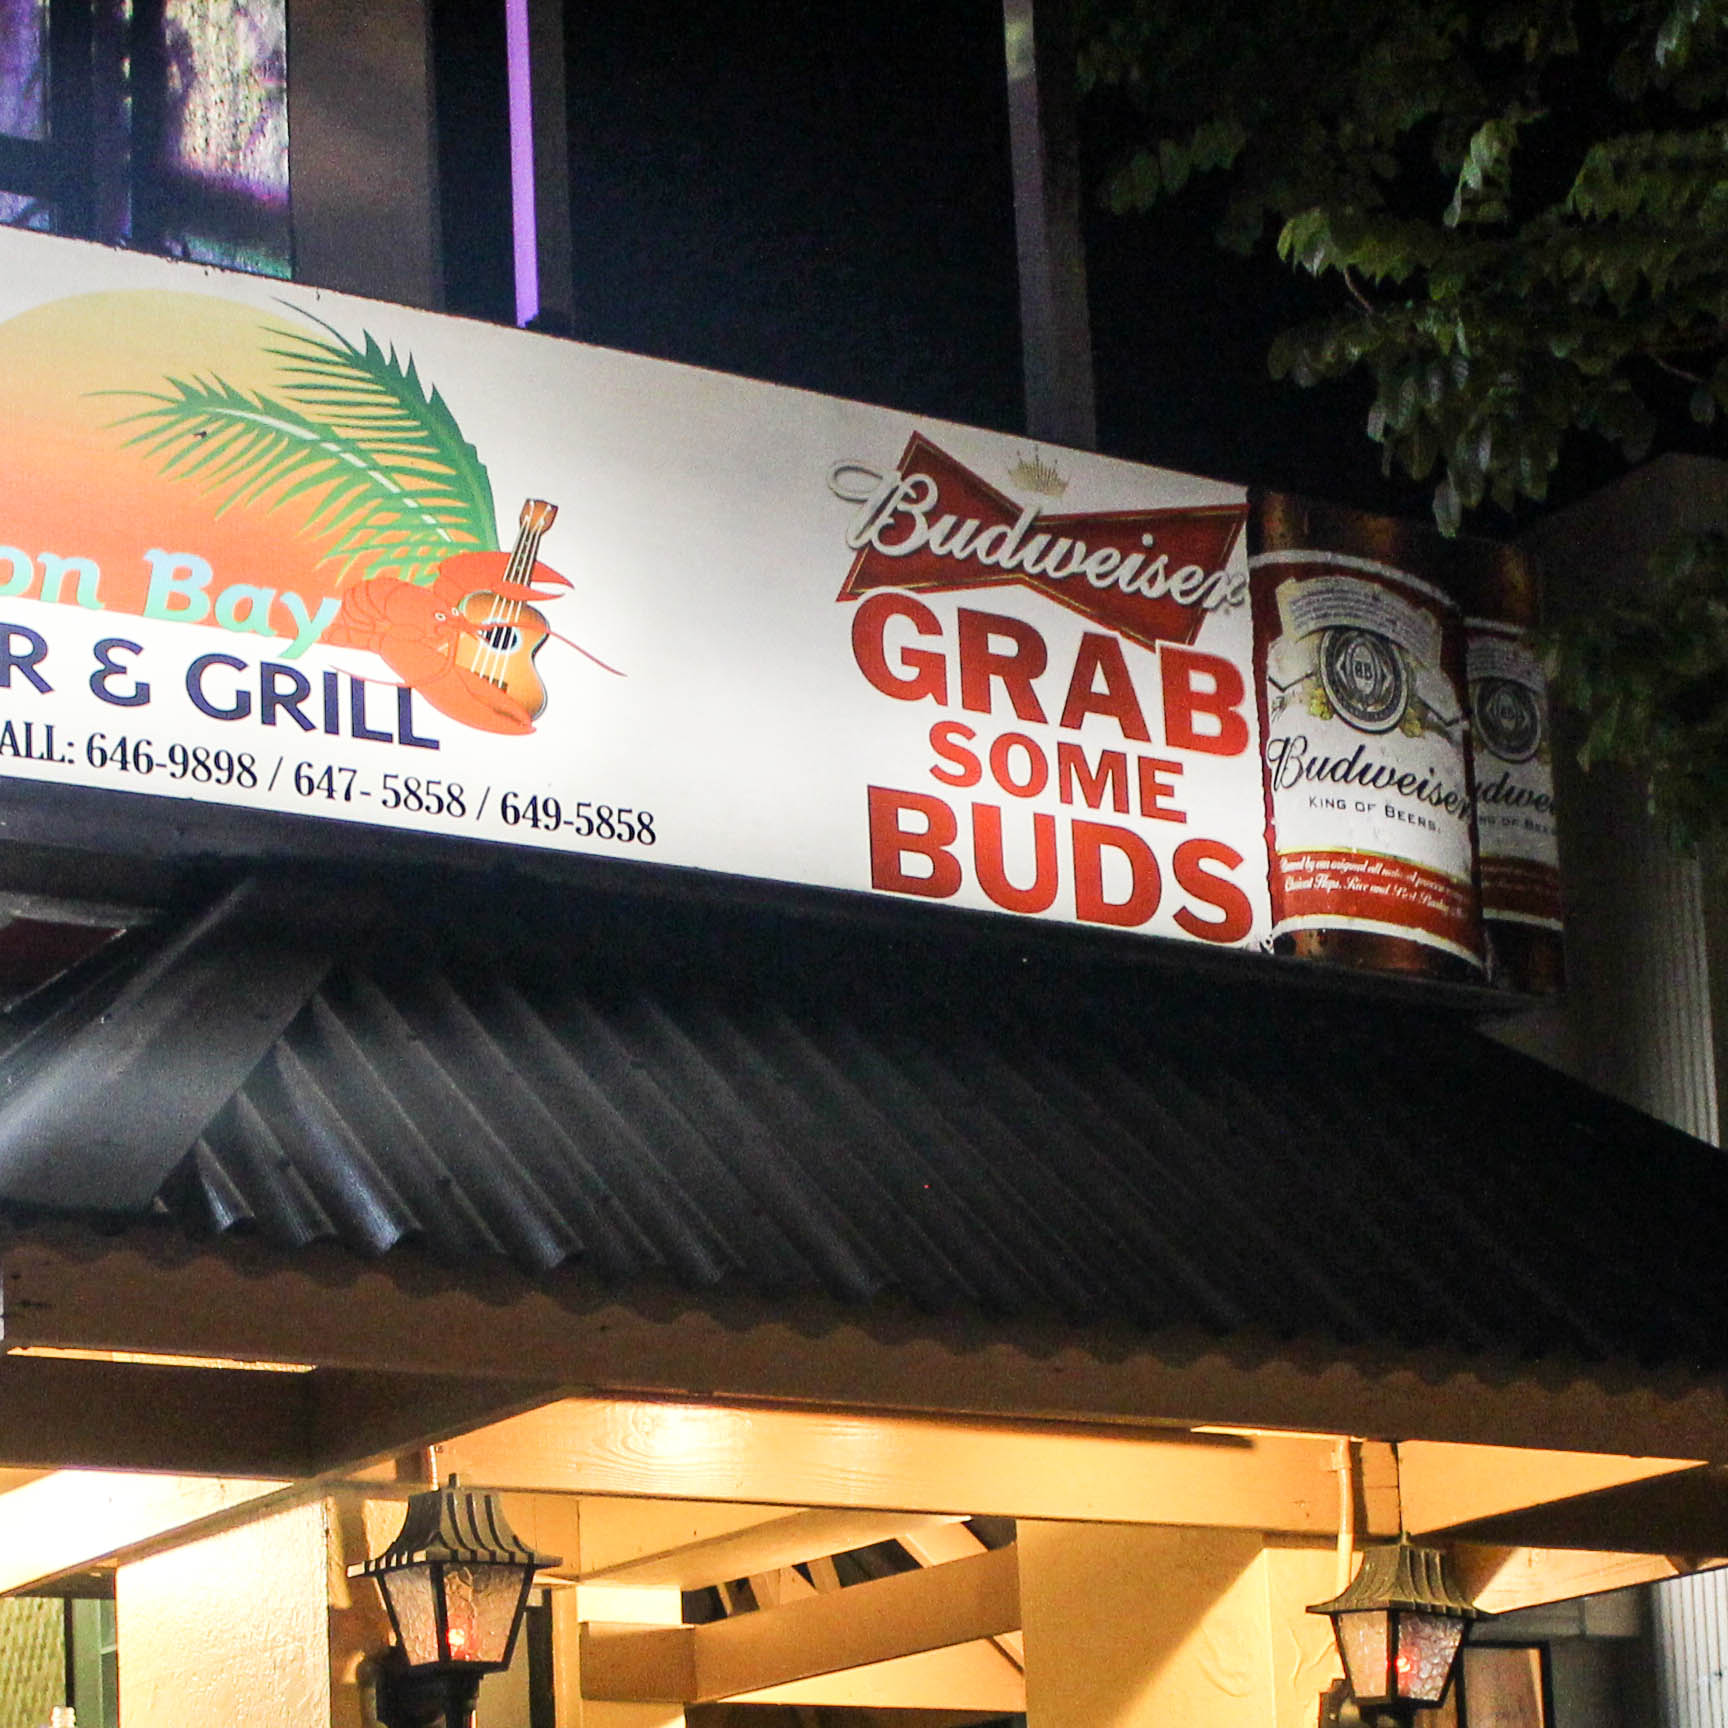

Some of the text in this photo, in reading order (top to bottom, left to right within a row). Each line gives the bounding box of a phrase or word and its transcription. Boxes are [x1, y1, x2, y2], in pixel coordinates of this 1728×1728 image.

[826, 458, 1251, 613] Budweiser
[143, 547, 343, 659] Bay
[88, 637, 151, 708] &
[185, 652, 440, 751] GRILL
[850, 590, 1254, 757] GRAB
[85, 731, 258, 789] 646-9898
[499, 790, 658, 846] 649-5858
[928, 719, 1188, 825] SOME
[1265, 734, 1474, 826] Budweiser
[1308, 795, 1347, 811] KING
[1355, 802, 1377, 813] OF
[866, 783, 1255, 944] BUDS
